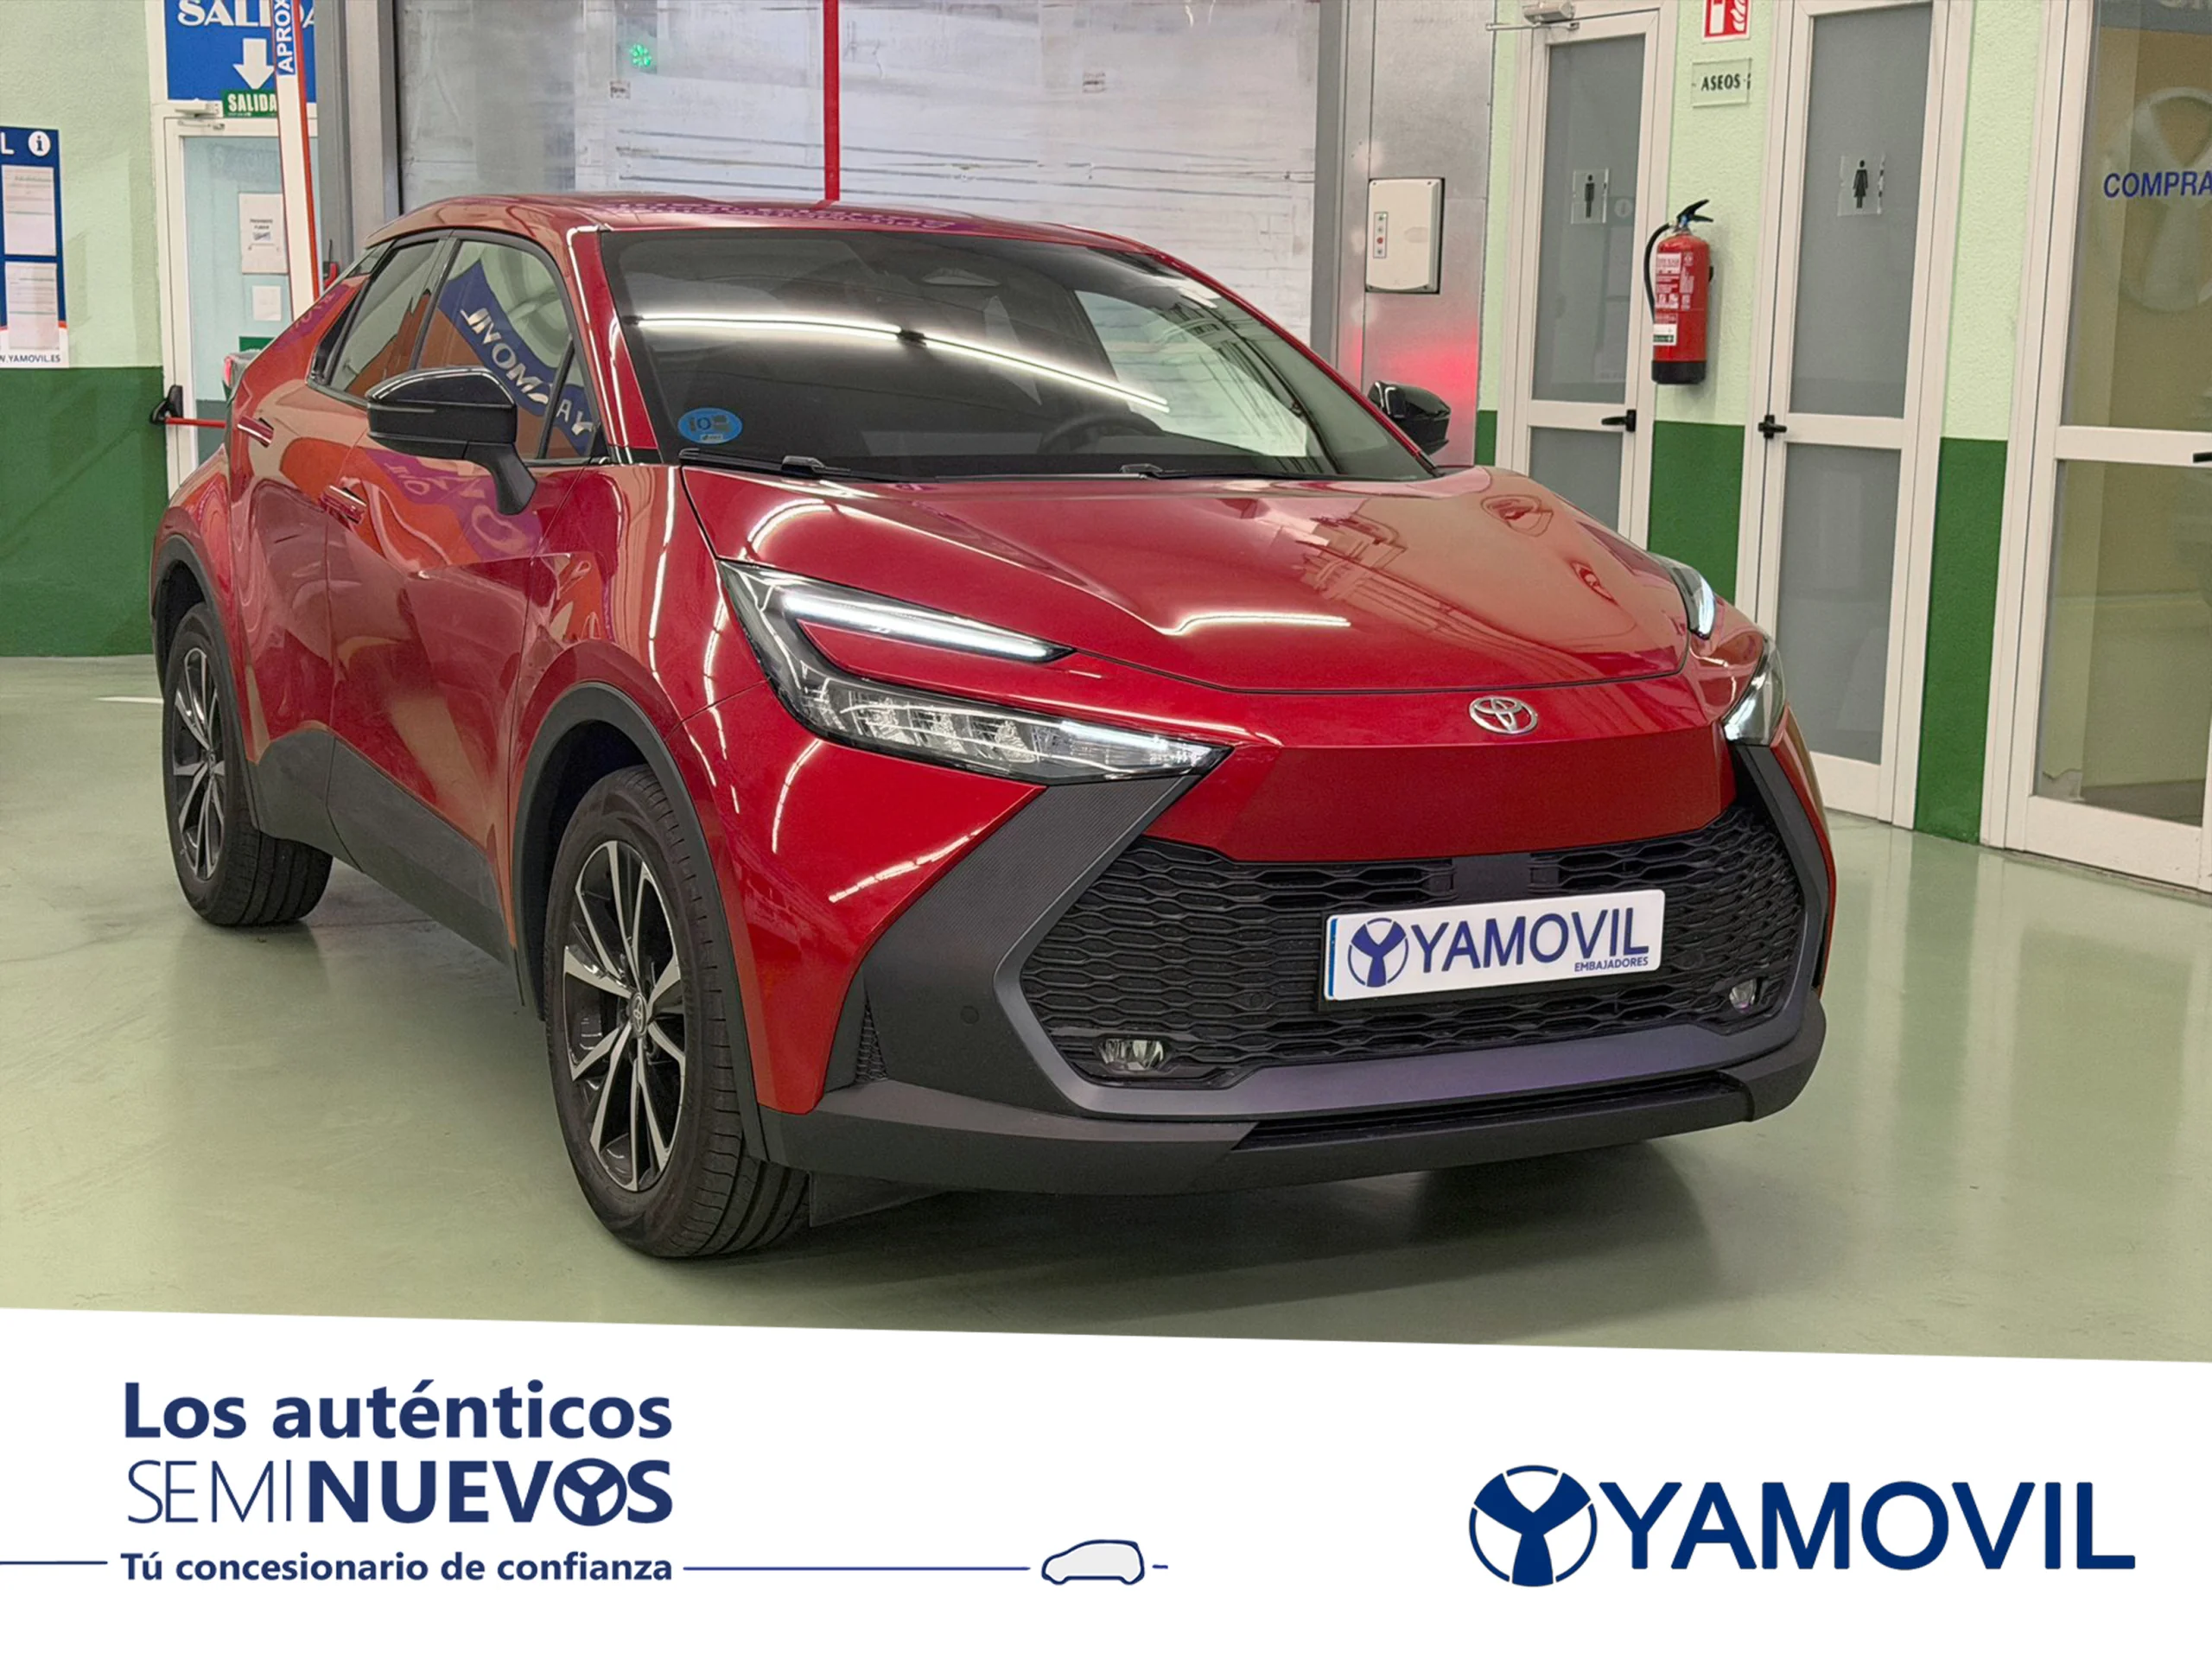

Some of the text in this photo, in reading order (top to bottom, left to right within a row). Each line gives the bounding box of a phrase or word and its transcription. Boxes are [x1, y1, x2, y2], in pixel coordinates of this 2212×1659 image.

[1700, 73, 1741, 92] ASEOS
[227, 93, 277, 112] SALIDA
[1411, 906, 1649, 974] YAMOVIL
[1573, 955, 1649, 972] EMBAJADORES
